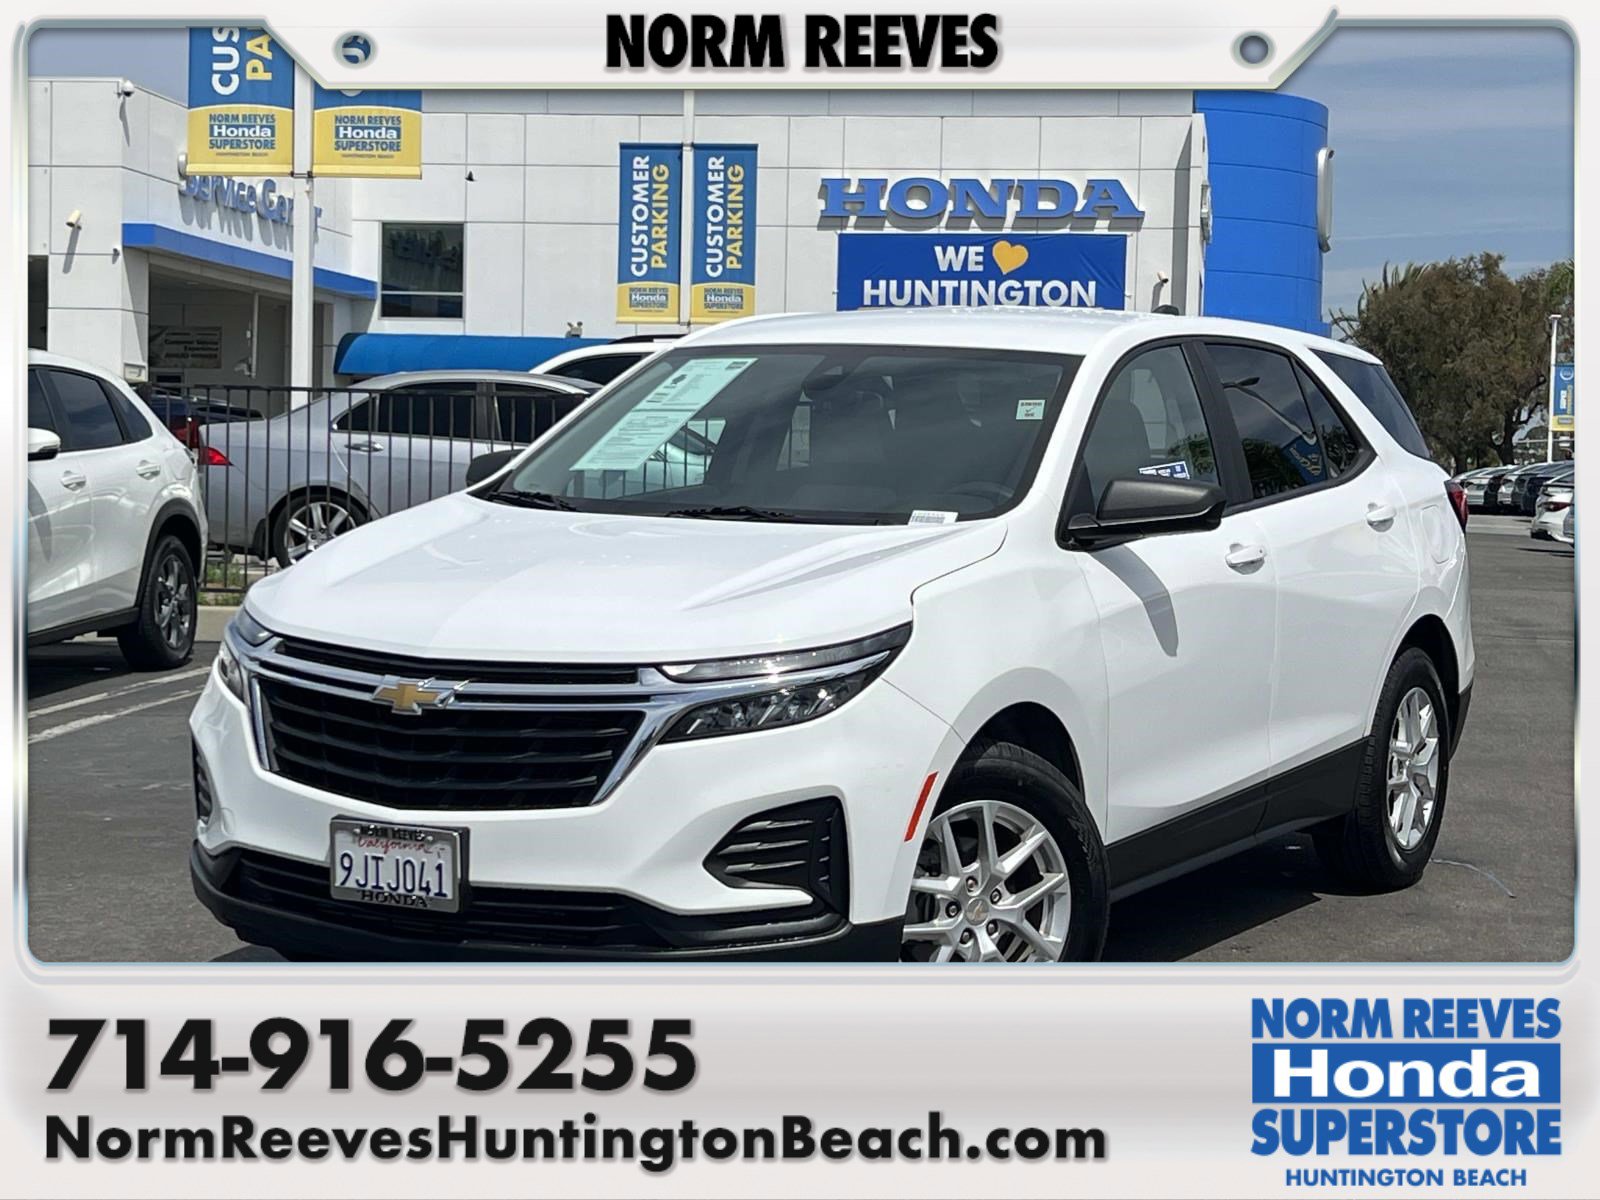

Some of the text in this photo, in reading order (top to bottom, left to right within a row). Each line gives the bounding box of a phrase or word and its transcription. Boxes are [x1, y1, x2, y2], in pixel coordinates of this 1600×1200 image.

[209, 113, 276, 124] NORM REEVES
[334, 115, 402, 126] NORM REEVES
[213, 125, 271, 137] Honda
[338, 126, 397, 139] Honda
[208, 138, 276, 150] SUPERSTORE
[334, 140, 402, 152] SUPERSTORE
[819, 177, 1145, 219] HONDA
[631, 155, 649, 277] CUSTOMER
[651, 164, 669, 268] PARKING
[706, 156, 724, 277] CUSTOMER
[726, 165, 744, 269] PARKING
[934, 245, 984, 272] WE
[631, 293, 666, 302] Honda
[706, 294, 742, 303] Honda
[862, 279, 1096, 307] HUNTINGTON
[340, 853, 447, 898] 9JIJ041
[361, 890, 428, 908] HONDA
